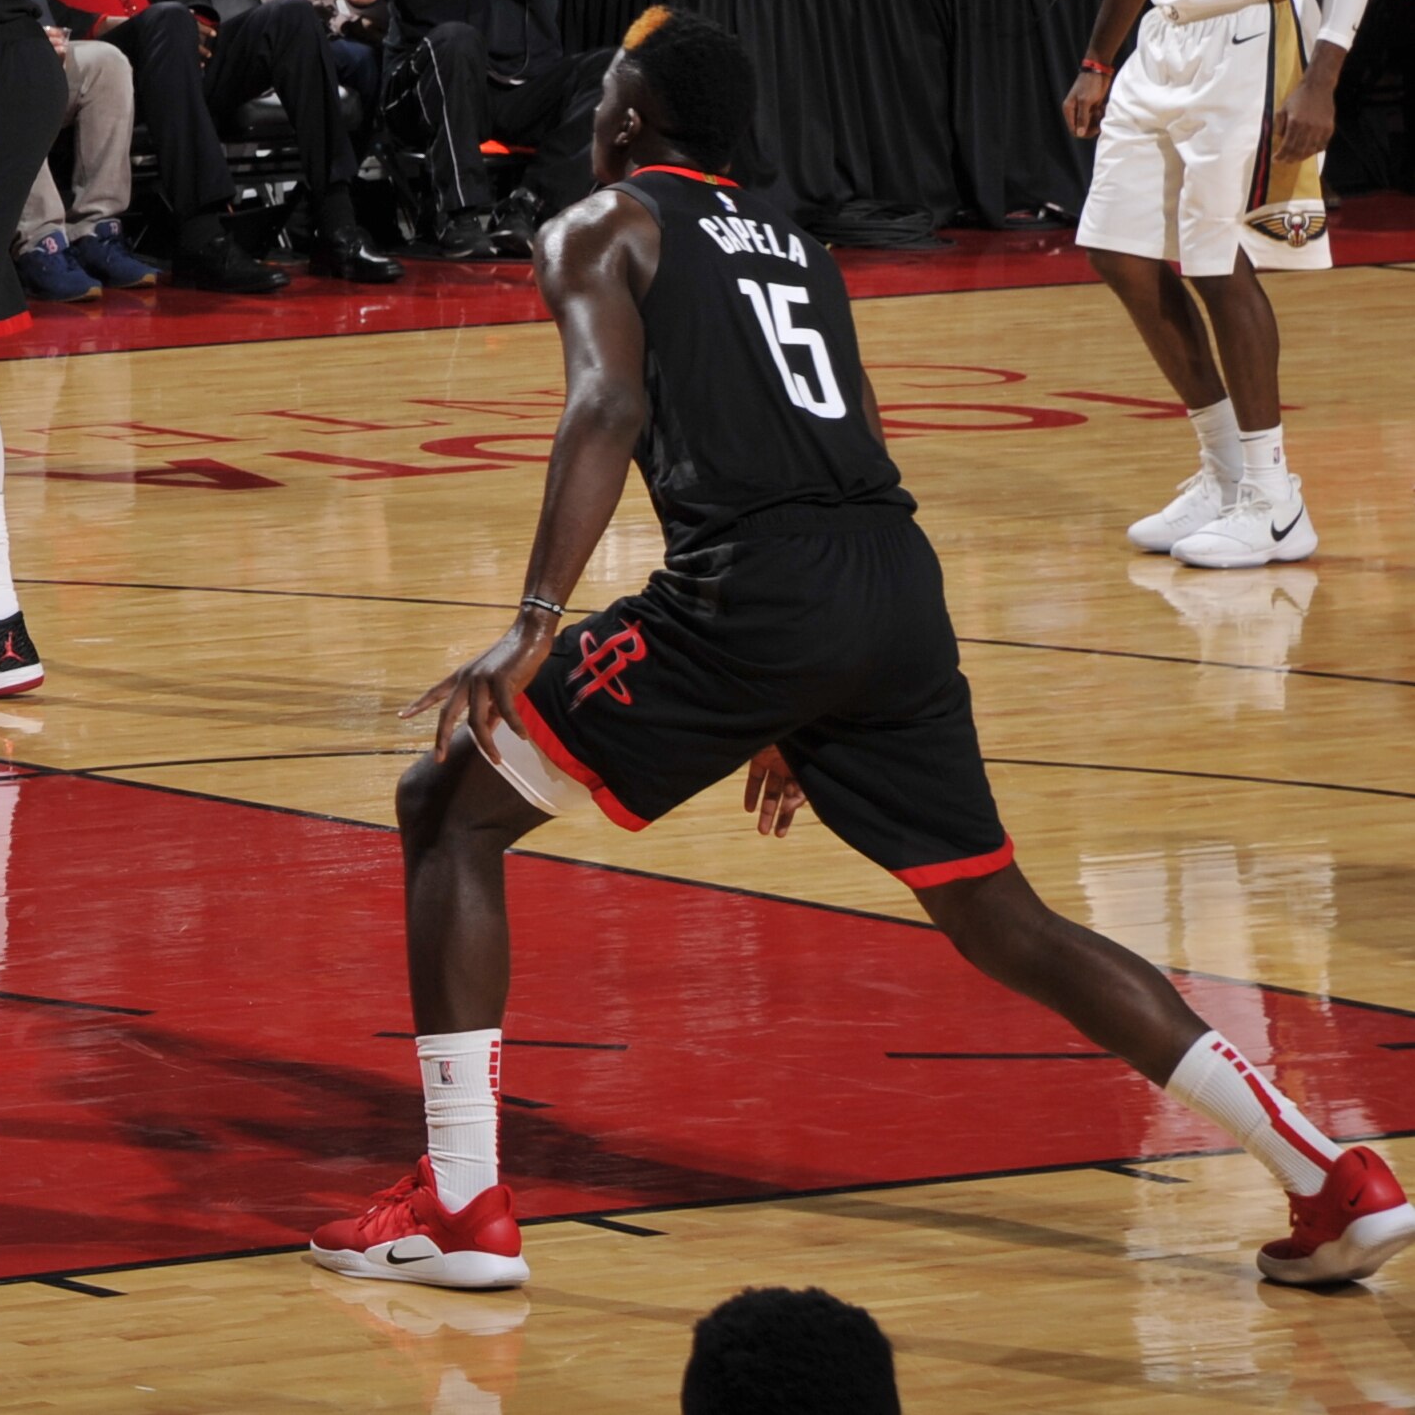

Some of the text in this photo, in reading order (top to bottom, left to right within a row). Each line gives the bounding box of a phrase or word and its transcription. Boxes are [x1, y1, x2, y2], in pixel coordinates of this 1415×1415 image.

[697, 215, 809, 269] CAPELA
[737, 277, 848, 420] 15
[20, 390, 1305, 491] TOOTA
